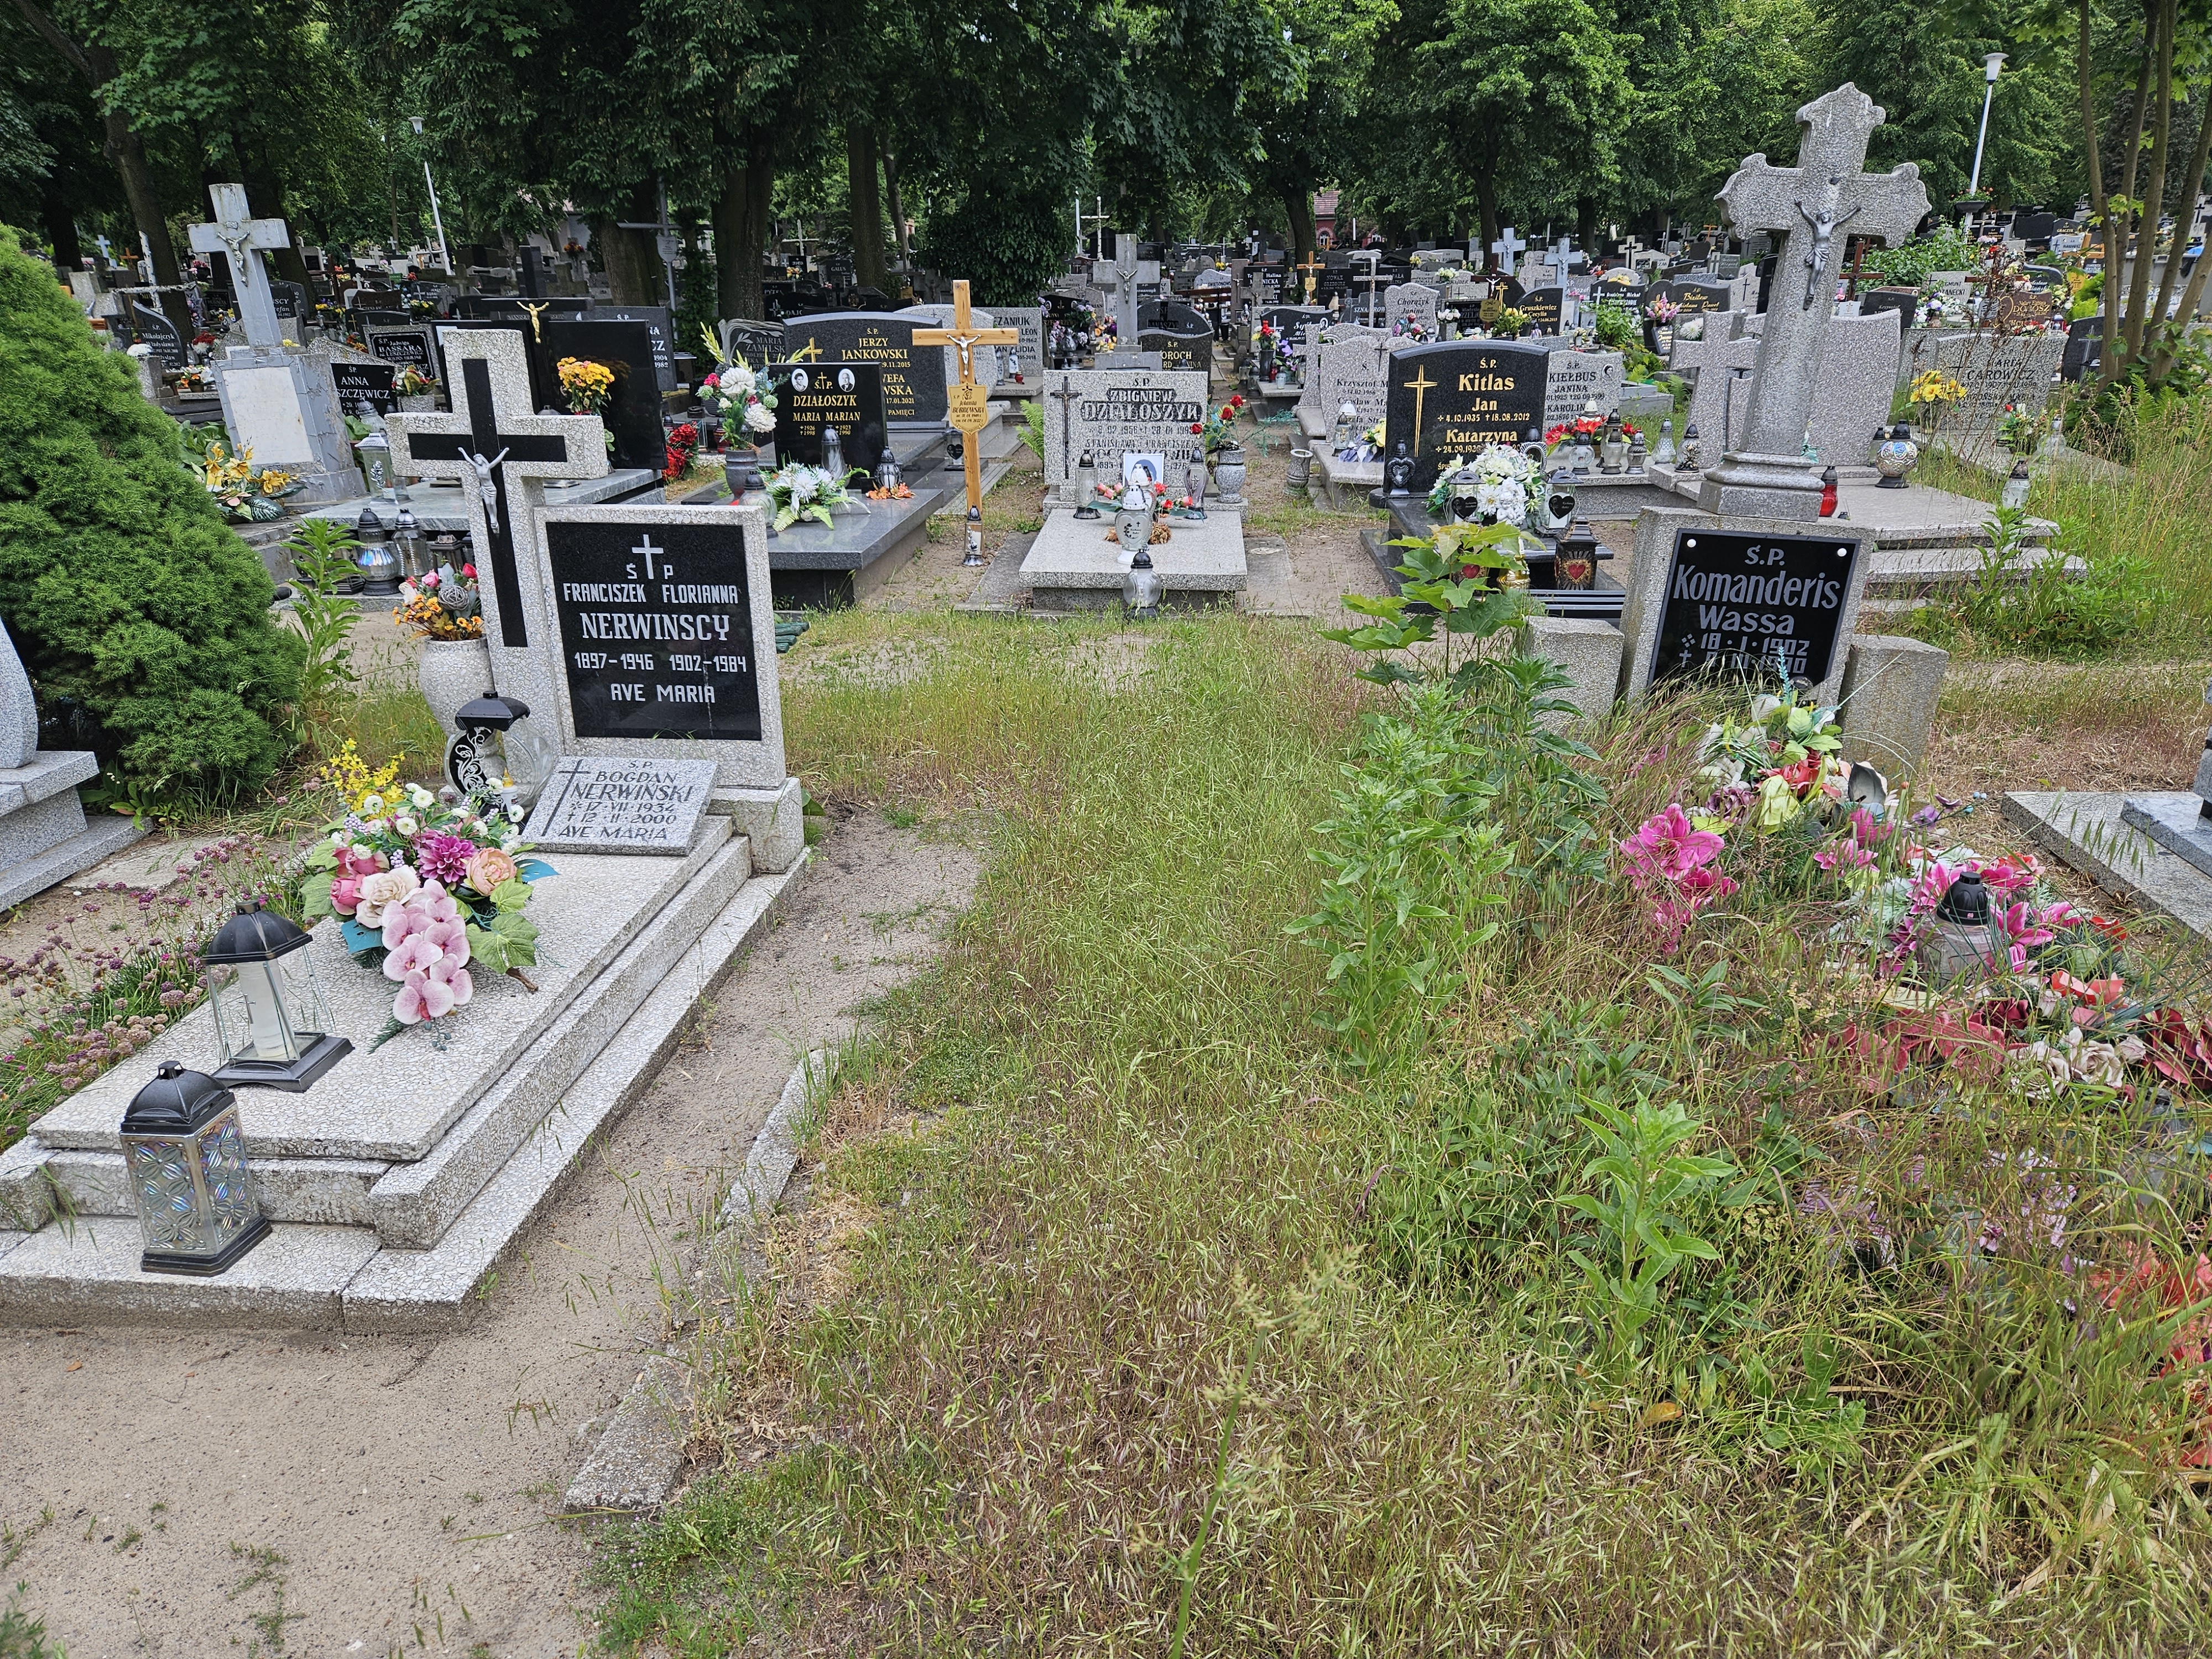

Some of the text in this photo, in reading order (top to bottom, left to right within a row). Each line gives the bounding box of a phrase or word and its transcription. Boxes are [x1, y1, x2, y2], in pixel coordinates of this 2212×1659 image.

[1397, 298, 1429, 307] Chorążyk
[859, 338, 889, 348] JERZY
[842, 349, 908, 361] JANKOWSKI
[1549, 372, 1597, 382] KIEŁBUS
[1967, 369, 2036, 380] CAROWICZ
[341, 377, 369, 386] ANNA
[1337, 378, 1377, 388] Krzysztof
[1458, 373, 1515, 391] Kitlas
[1554, 385, 1588, 393] JANINA
[793, 395, 857, 406] DZIAŁOSZYK
[1109, 390, 1173, 402] ZBIGNIEW
[1472, 398, 1498, 411] Jan
[792, 411, 860, 421] MARIA MARIAN
[1084, 403, 1198, 420] DZIAŁOSZYK
[1446, 429, 1517, 444] Katarzyna
[1673, 564, 1841, 609] Komanderis
[563, 583, 738, 604] FRANCISZEK FLORIANNA
[1699, 604, 1795, 635] Wassa
[580, 613, 729, 641] NERWINSCY
[611, 684, 716, 703] AVE MARIA
[595, 771, 677, 784] BOGDAN
[570, 783, 694, 802] NERWIŃSKI
[559, 826, 668, 841] AVE MARIA
